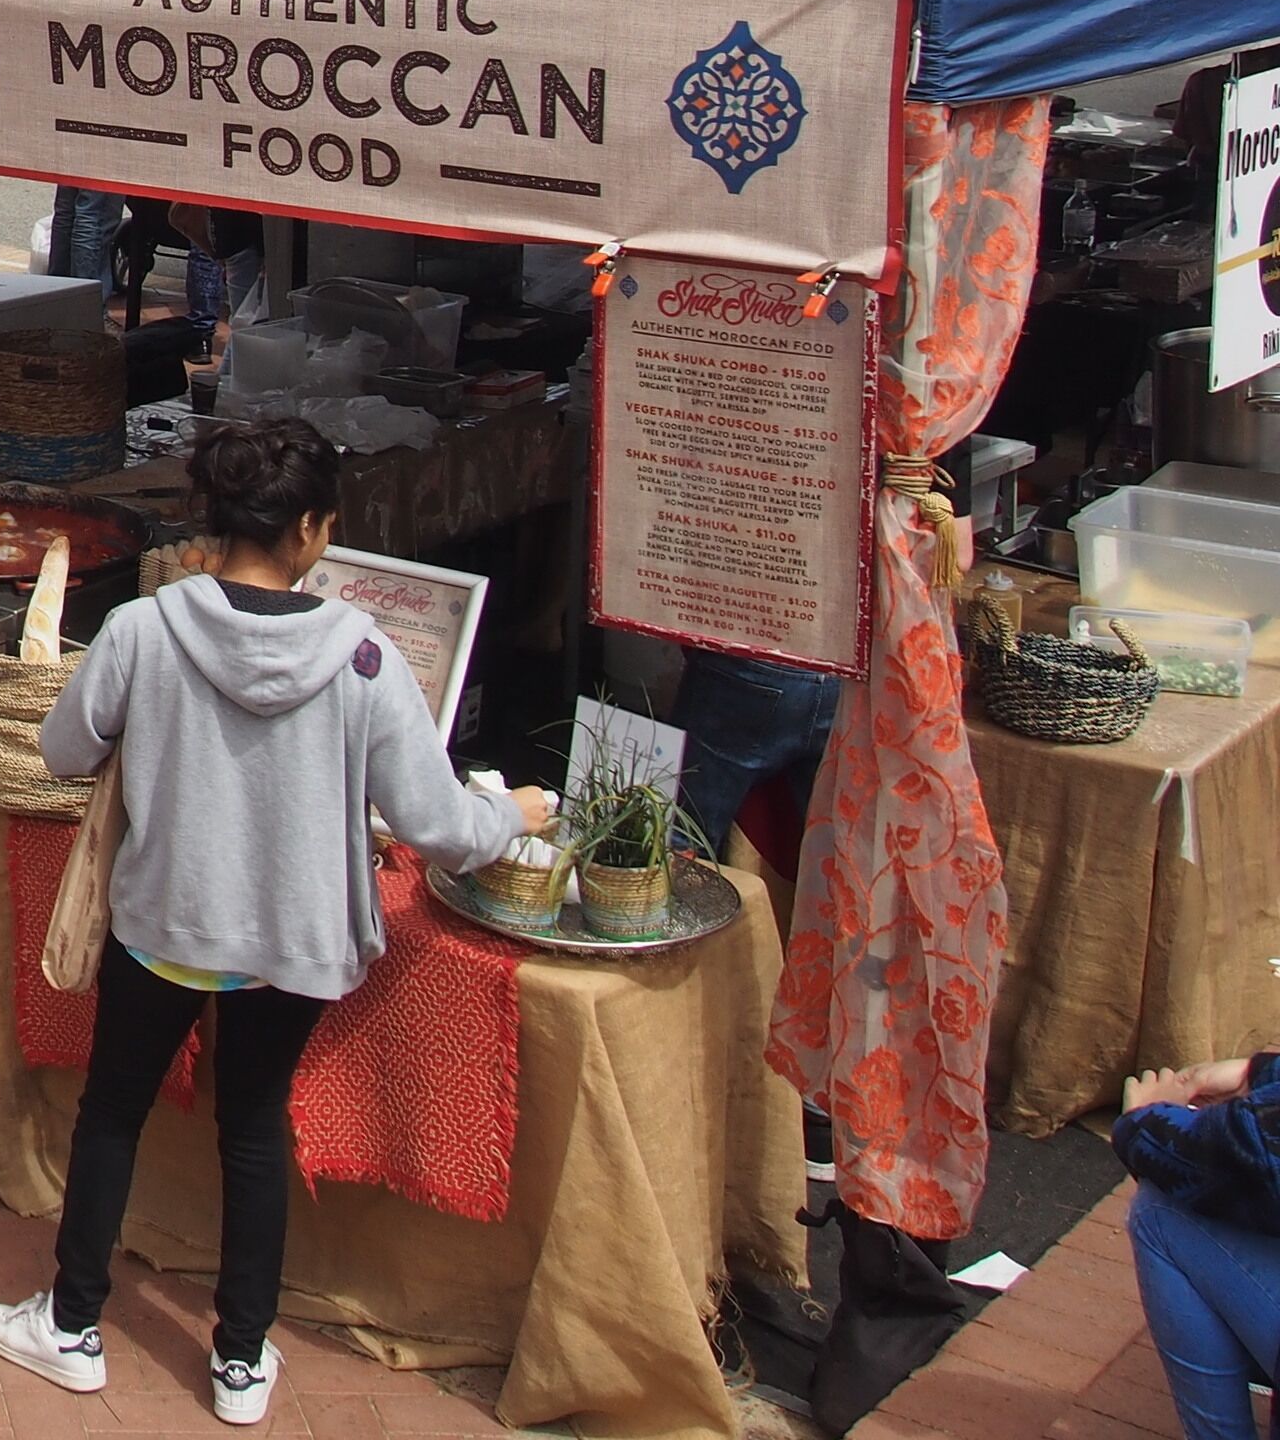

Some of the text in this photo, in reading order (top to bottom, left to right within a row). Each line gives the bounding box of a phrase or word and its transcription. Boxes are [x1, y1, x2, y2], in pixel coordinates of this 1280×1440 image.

[47, 21, 605, 144] MOROCCAN
[223, 124, 401, 187] FOOD
[658, 275, 804, 327] Shak Shuka
[631, 320, 834, 355] AUTHENTIC MOROCCAN FOOD
[637, 347, 825, 382] SHAK SHUKA COMBO $15.00
[625, 402, 838, 442] VEGETARIAN COUSCOUS $13.00
[625, 449, 836, 491] SHAK SHUKA SAUSAUGE $13.00
[657, 511, 796, 543] SHAK SHUKA $11.00
[636, 568, 817, 608] EXTRA ORGANIC BAGUETTE $1.00
[639, 581, 814, 621] EXTRA CHORIZO SAUSAGE $3.00
[677, 612, 734, 631] EXTRA EGG
[719, 608, 751, 623] DRINK
